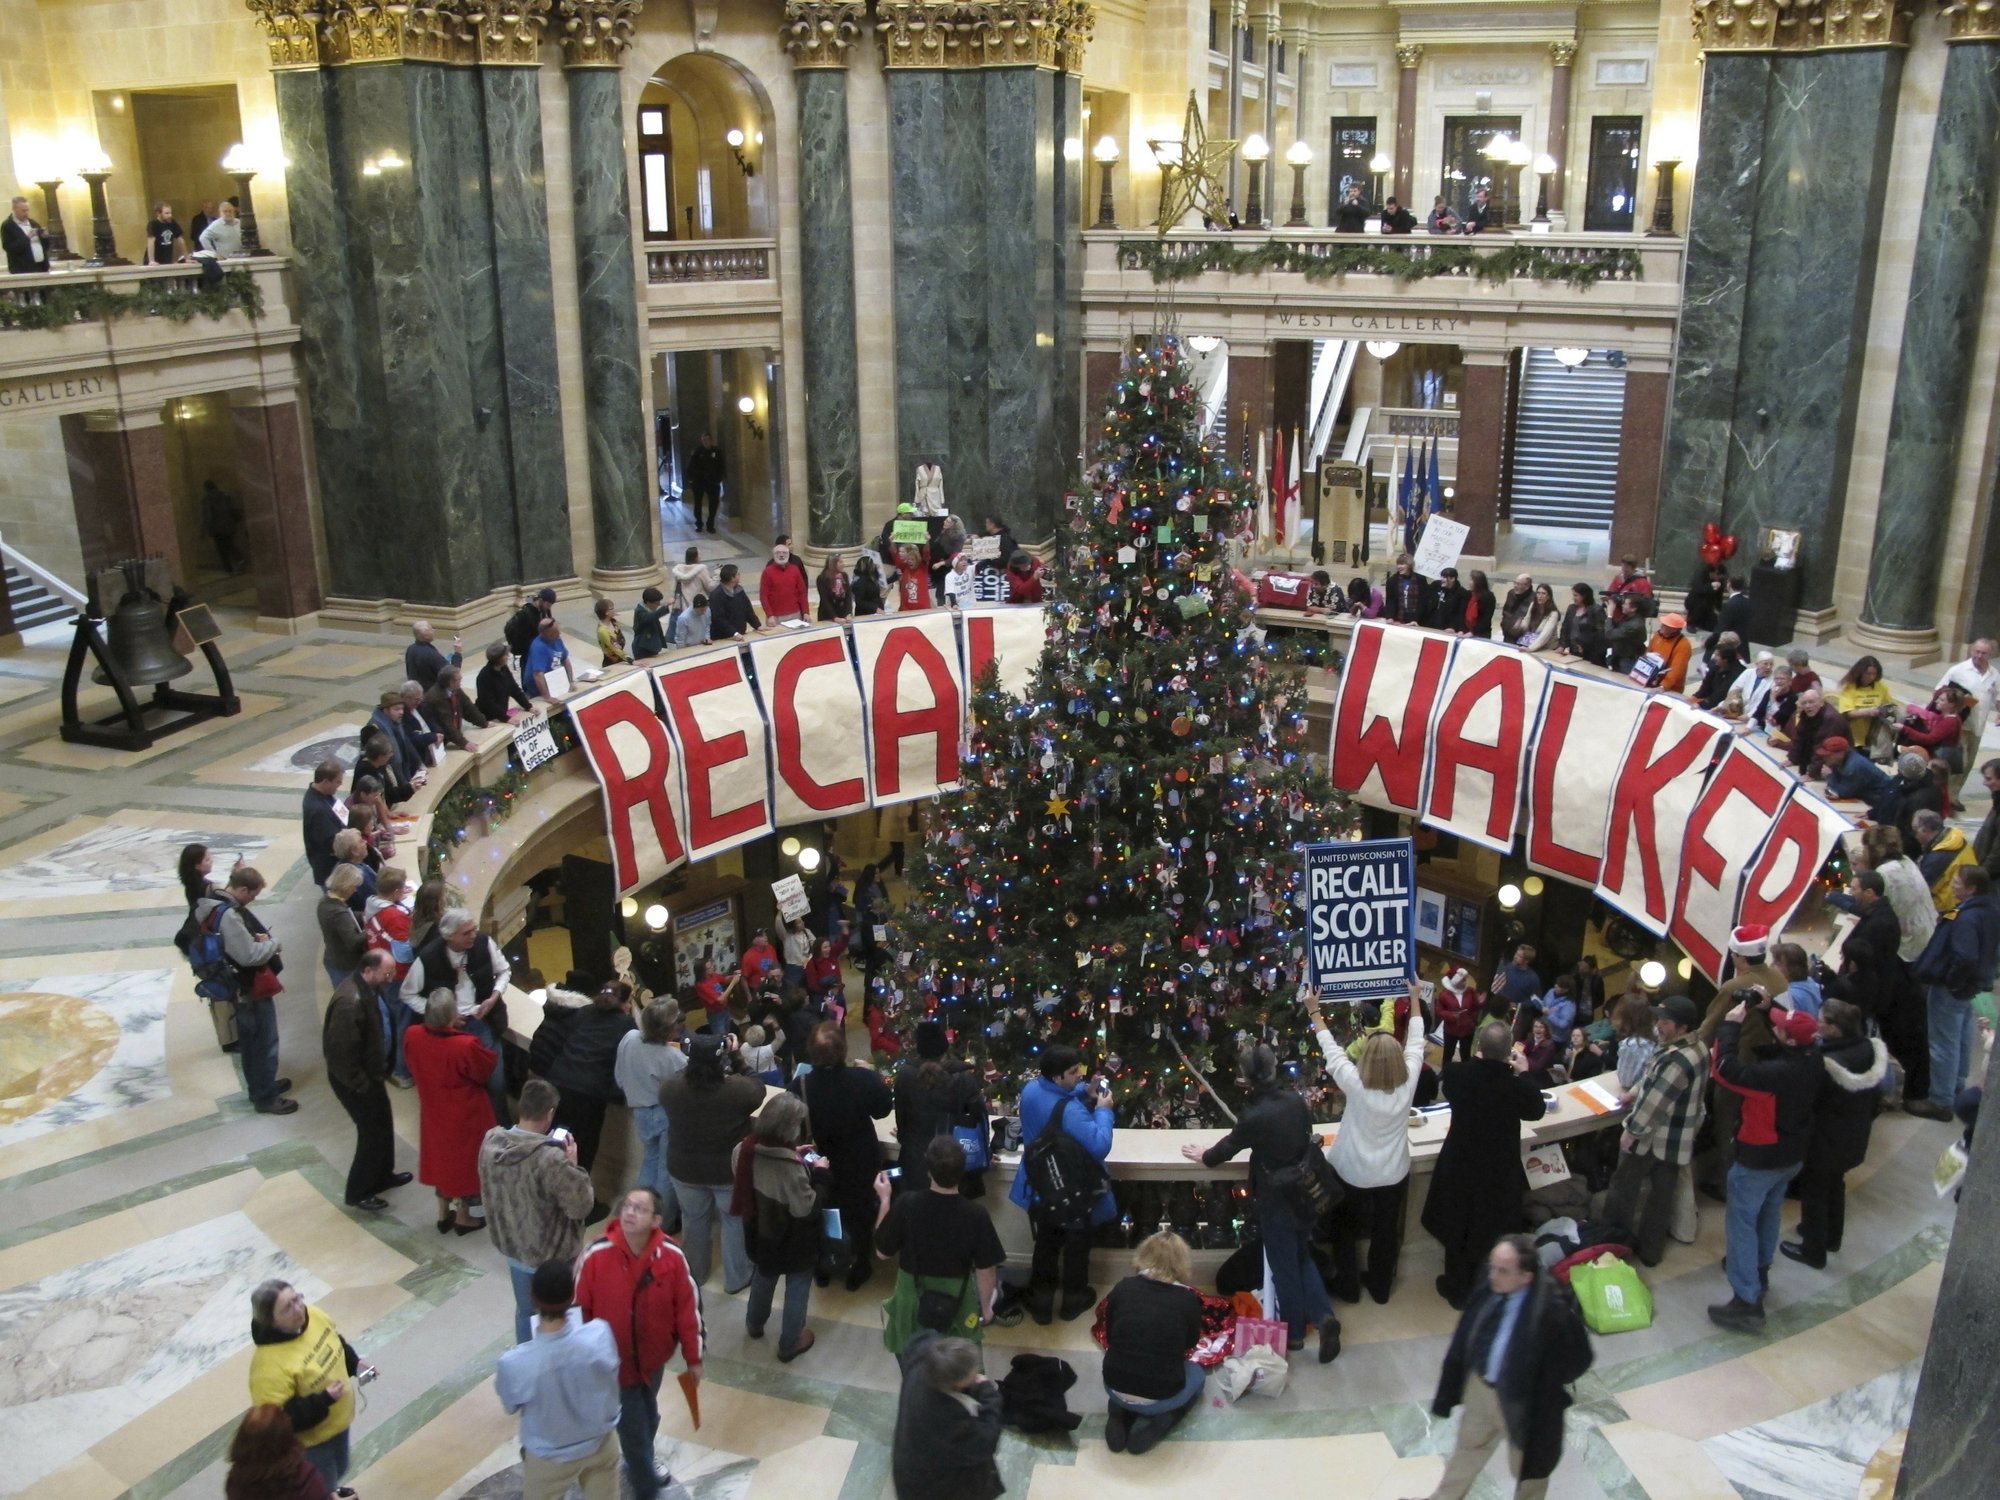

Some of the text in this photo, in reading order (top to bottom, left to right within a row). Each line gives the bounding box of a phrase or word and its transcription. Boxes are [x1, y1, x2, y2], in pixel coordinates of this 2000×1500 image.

[1278, 312, 1459, 331] WEST GALLERY
[0, 376, 104, 406] GALLERY
[984, 567, 1000, 600] COTT
[515, 719, 550, 747] FREEDOM
[522, 715, 534, 729] MY
[525, 744, 555, 769] SPEECH
[528, 739, 539, 752] OF
[1318, 853, 1348, 863] UNITED
[1349, 850, 1396, 861] WISCONSIN
[1397, 849, 1408, 858] TO
[1311, 863, 1408, 900] RECALL
[1312, 899, 1409, 941] SCOTT
[1314, 939, 1407, 970] WALKER
